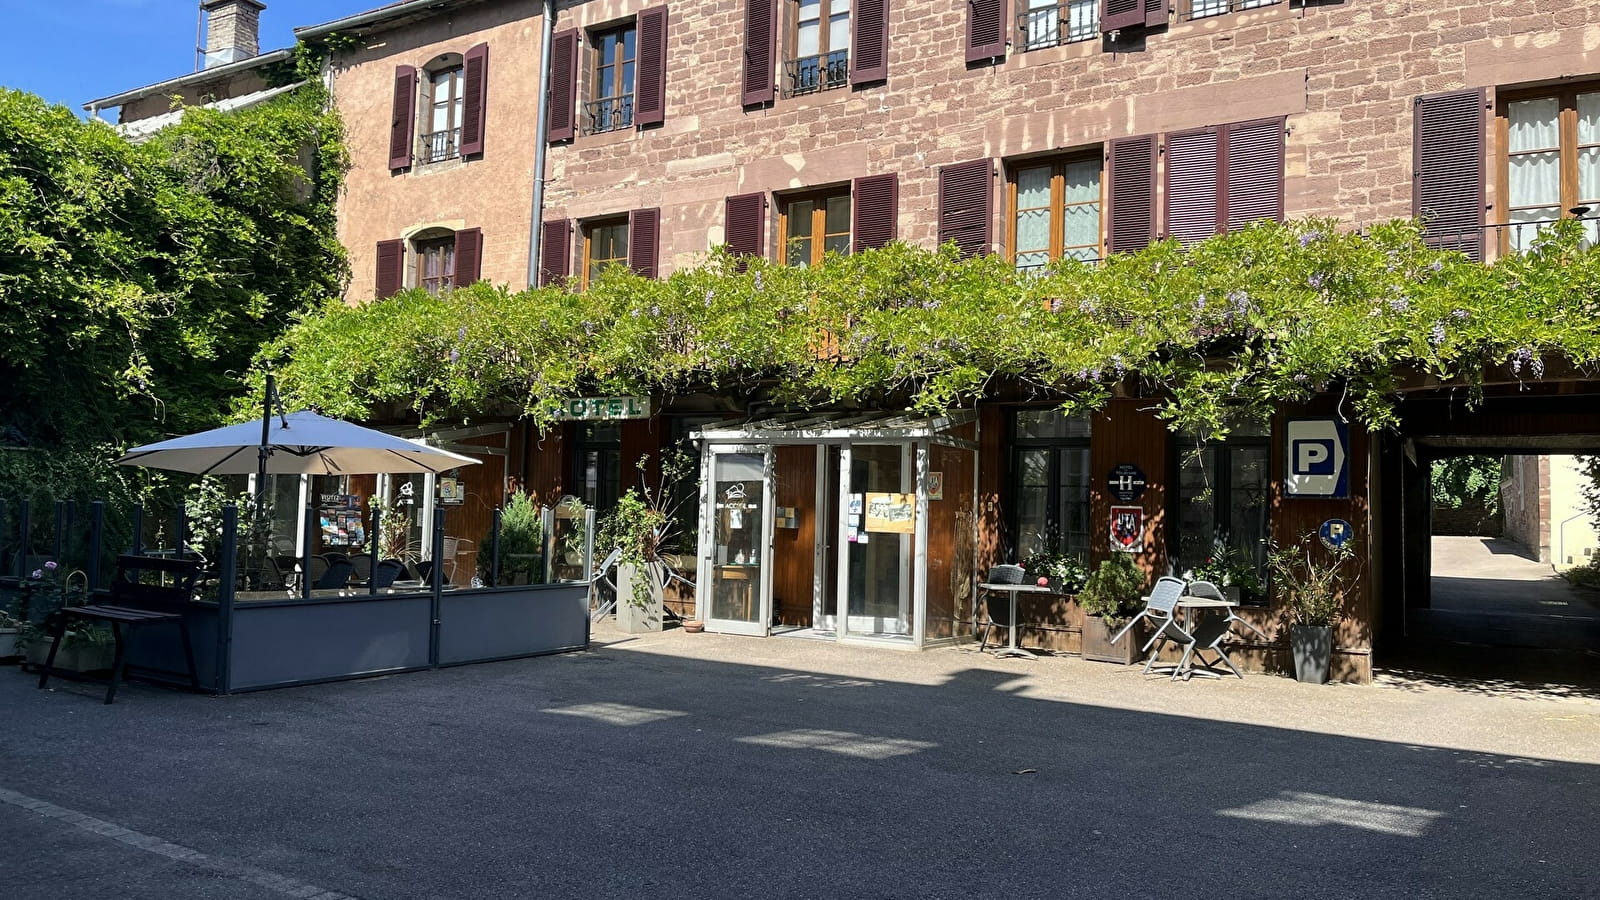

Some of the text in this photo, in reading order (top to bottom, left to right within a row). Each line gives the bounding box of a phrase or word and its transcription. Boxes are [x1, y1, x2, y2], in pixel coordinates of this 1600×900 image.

[1299, 443, 1328, 472] P
[1120, 475, 1132, 490] H
[1330, 523, 1344, 538] P
